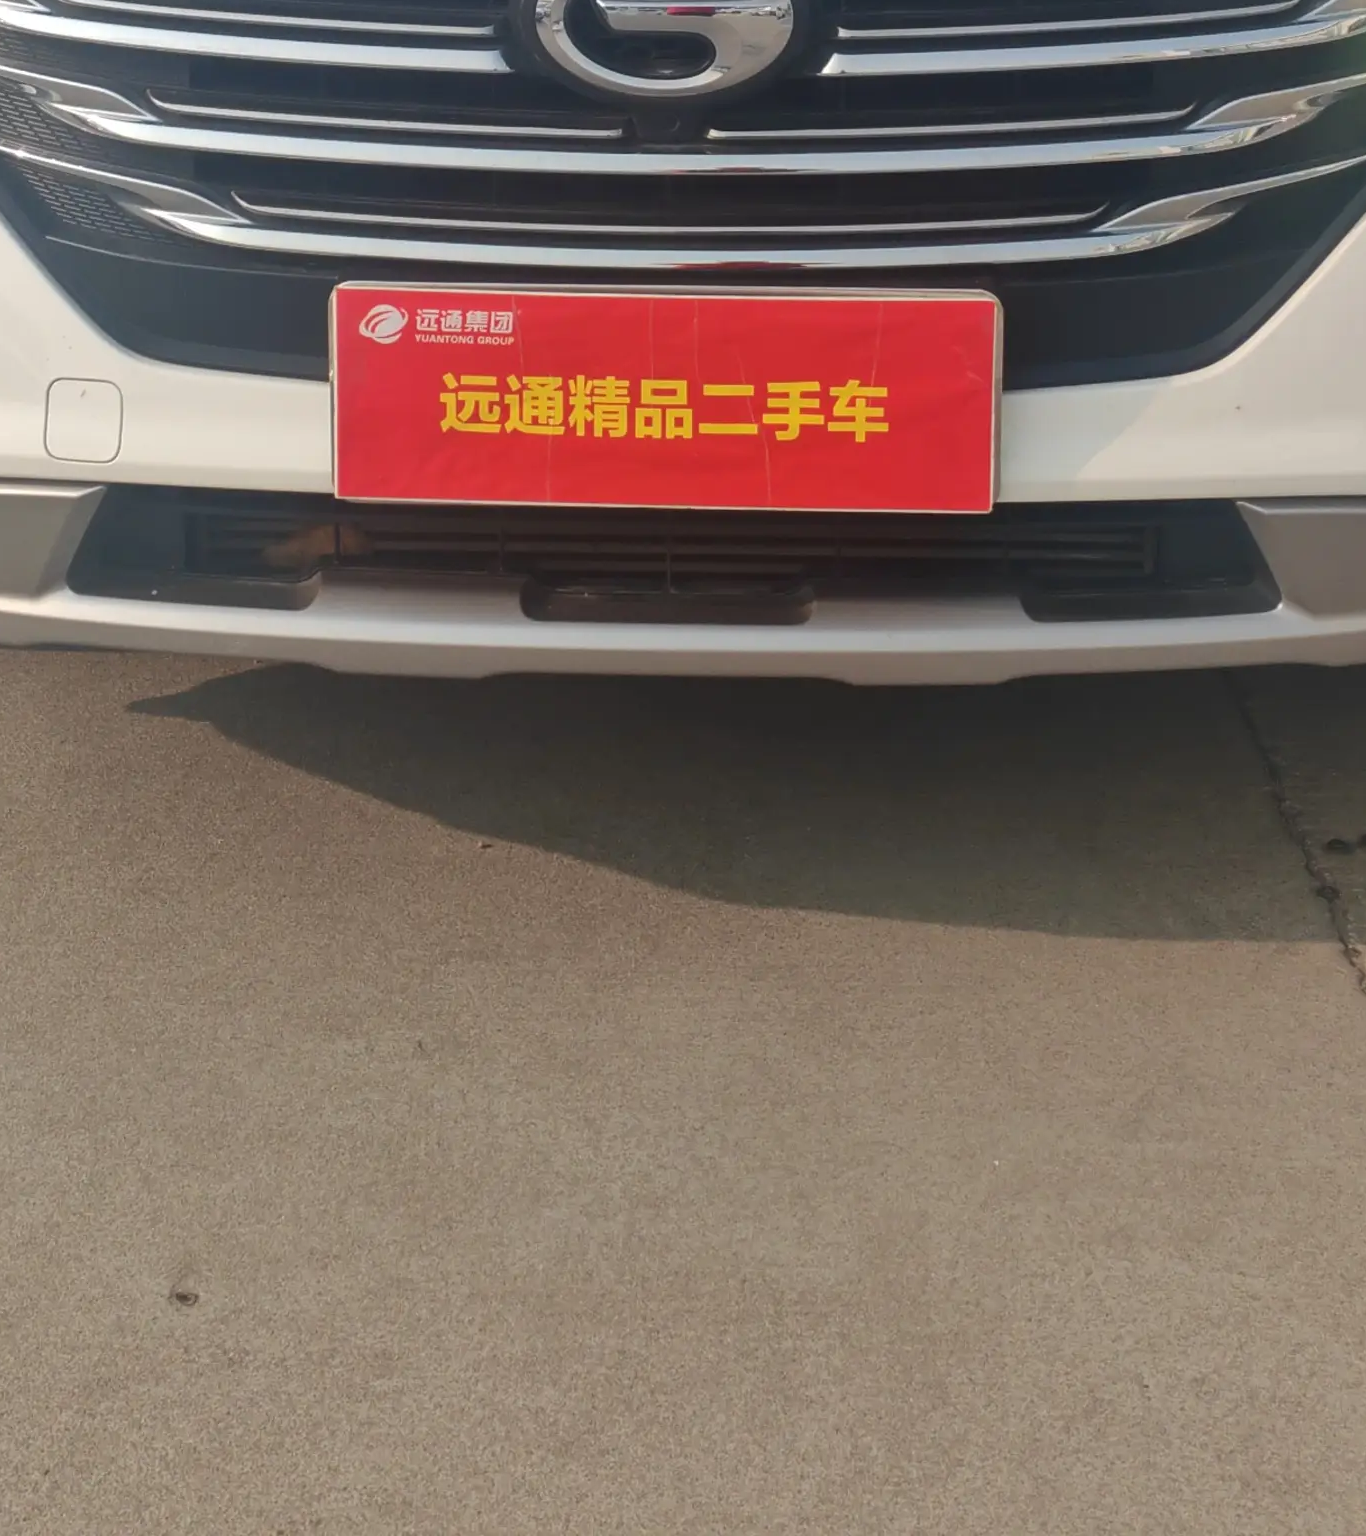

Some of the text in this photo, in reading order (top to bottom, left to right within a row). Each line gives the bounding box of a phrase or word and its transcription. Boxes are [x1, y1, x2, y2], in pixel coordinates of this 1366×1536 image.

[415, 308, 514, 335] 远通集团
[414, 334, 515, 346] YUANTONG GROUP
[439, 372, 890, 443] 远通精品二手车
